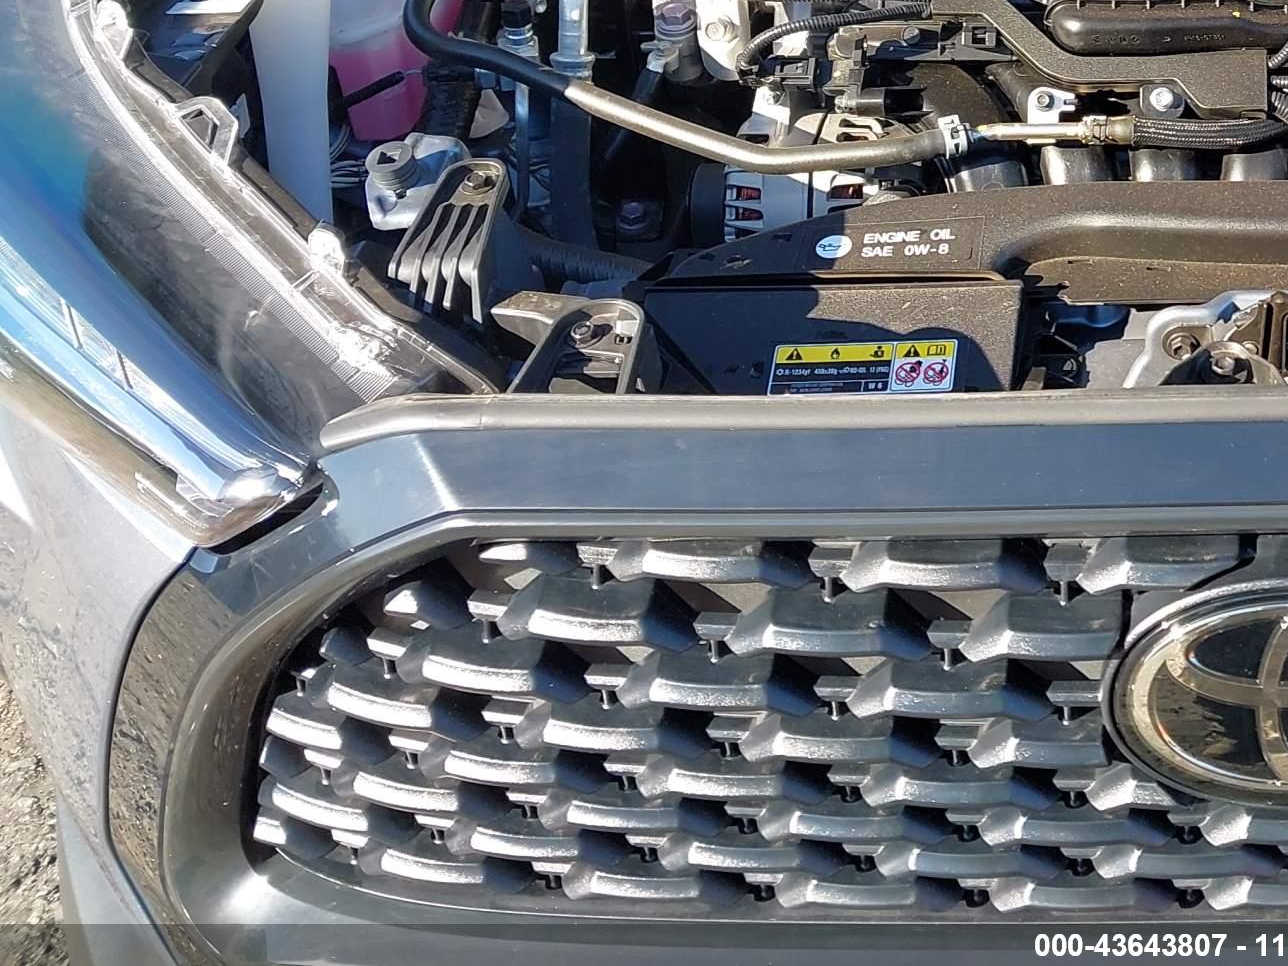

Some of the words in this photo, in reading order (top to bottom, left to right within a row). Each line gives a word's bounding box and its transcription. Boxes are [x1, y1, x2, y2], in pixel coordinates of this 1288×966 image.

[863, 230, 921, 244] ENGINE
[929, 228, 956, 241] OIL
[860, 245, 894, 258] SAE
[903, 243, 949, 256] 0W-8
